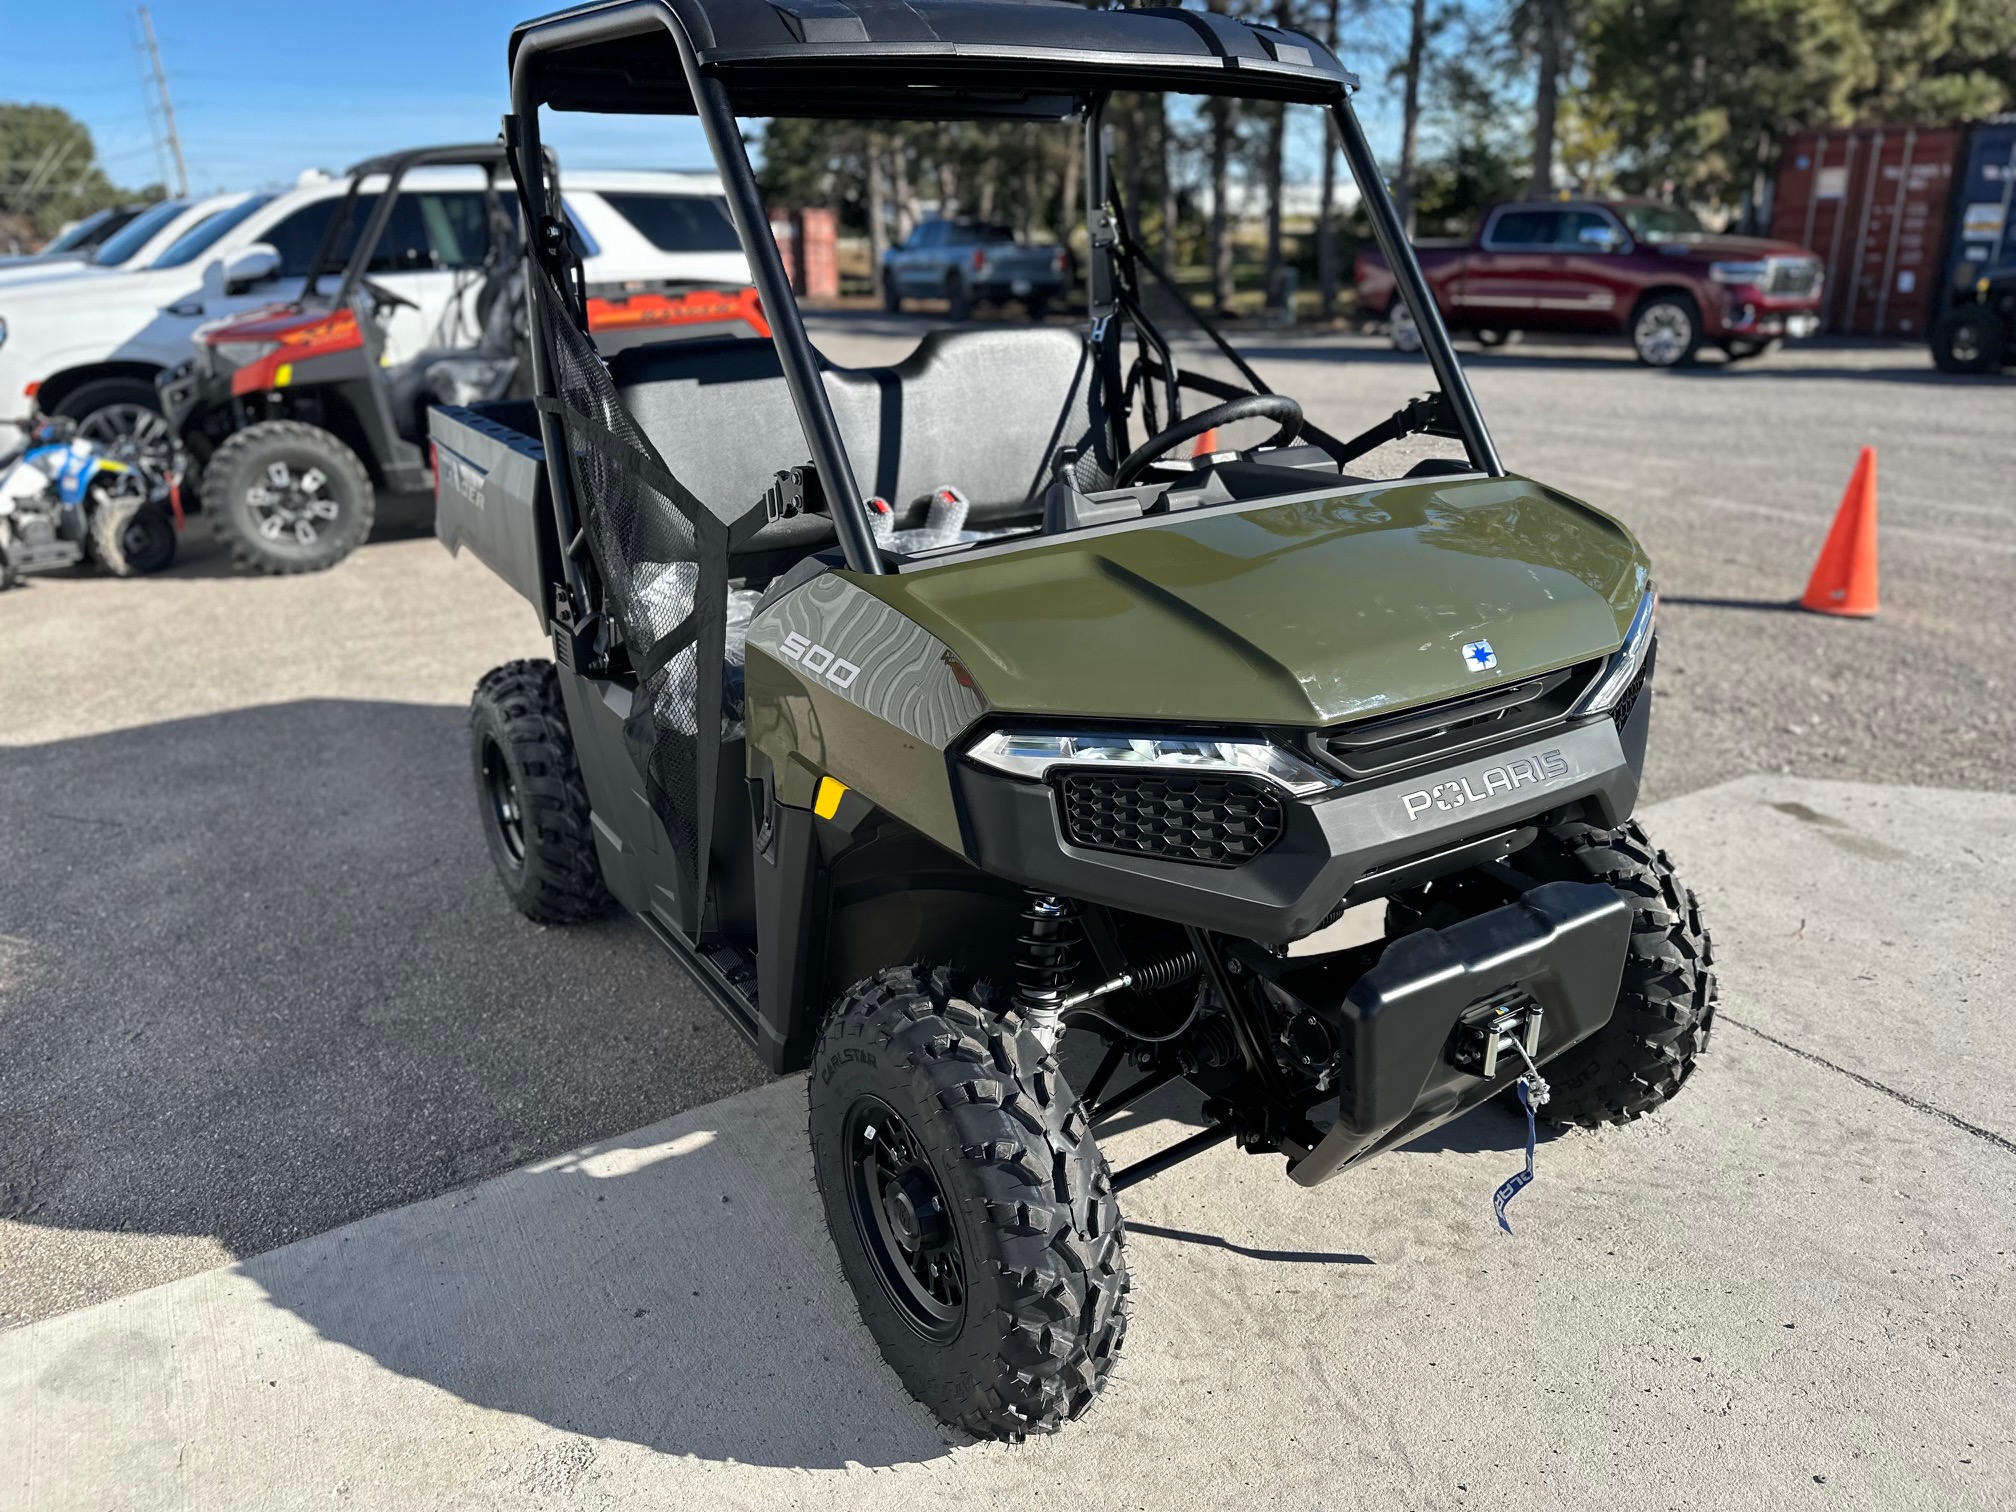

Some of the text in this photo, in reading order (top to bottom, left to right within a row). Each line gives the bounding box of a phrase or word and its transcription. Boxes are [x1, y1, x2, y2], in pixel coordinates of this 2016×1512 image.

[779, 630, 862, 689] 500
[1401, 749, 1567, 821] POLARIS
[822, 1048, 878, 1086] CARLSTAR
[1550, 1060, 1601, 1096] CARLS
